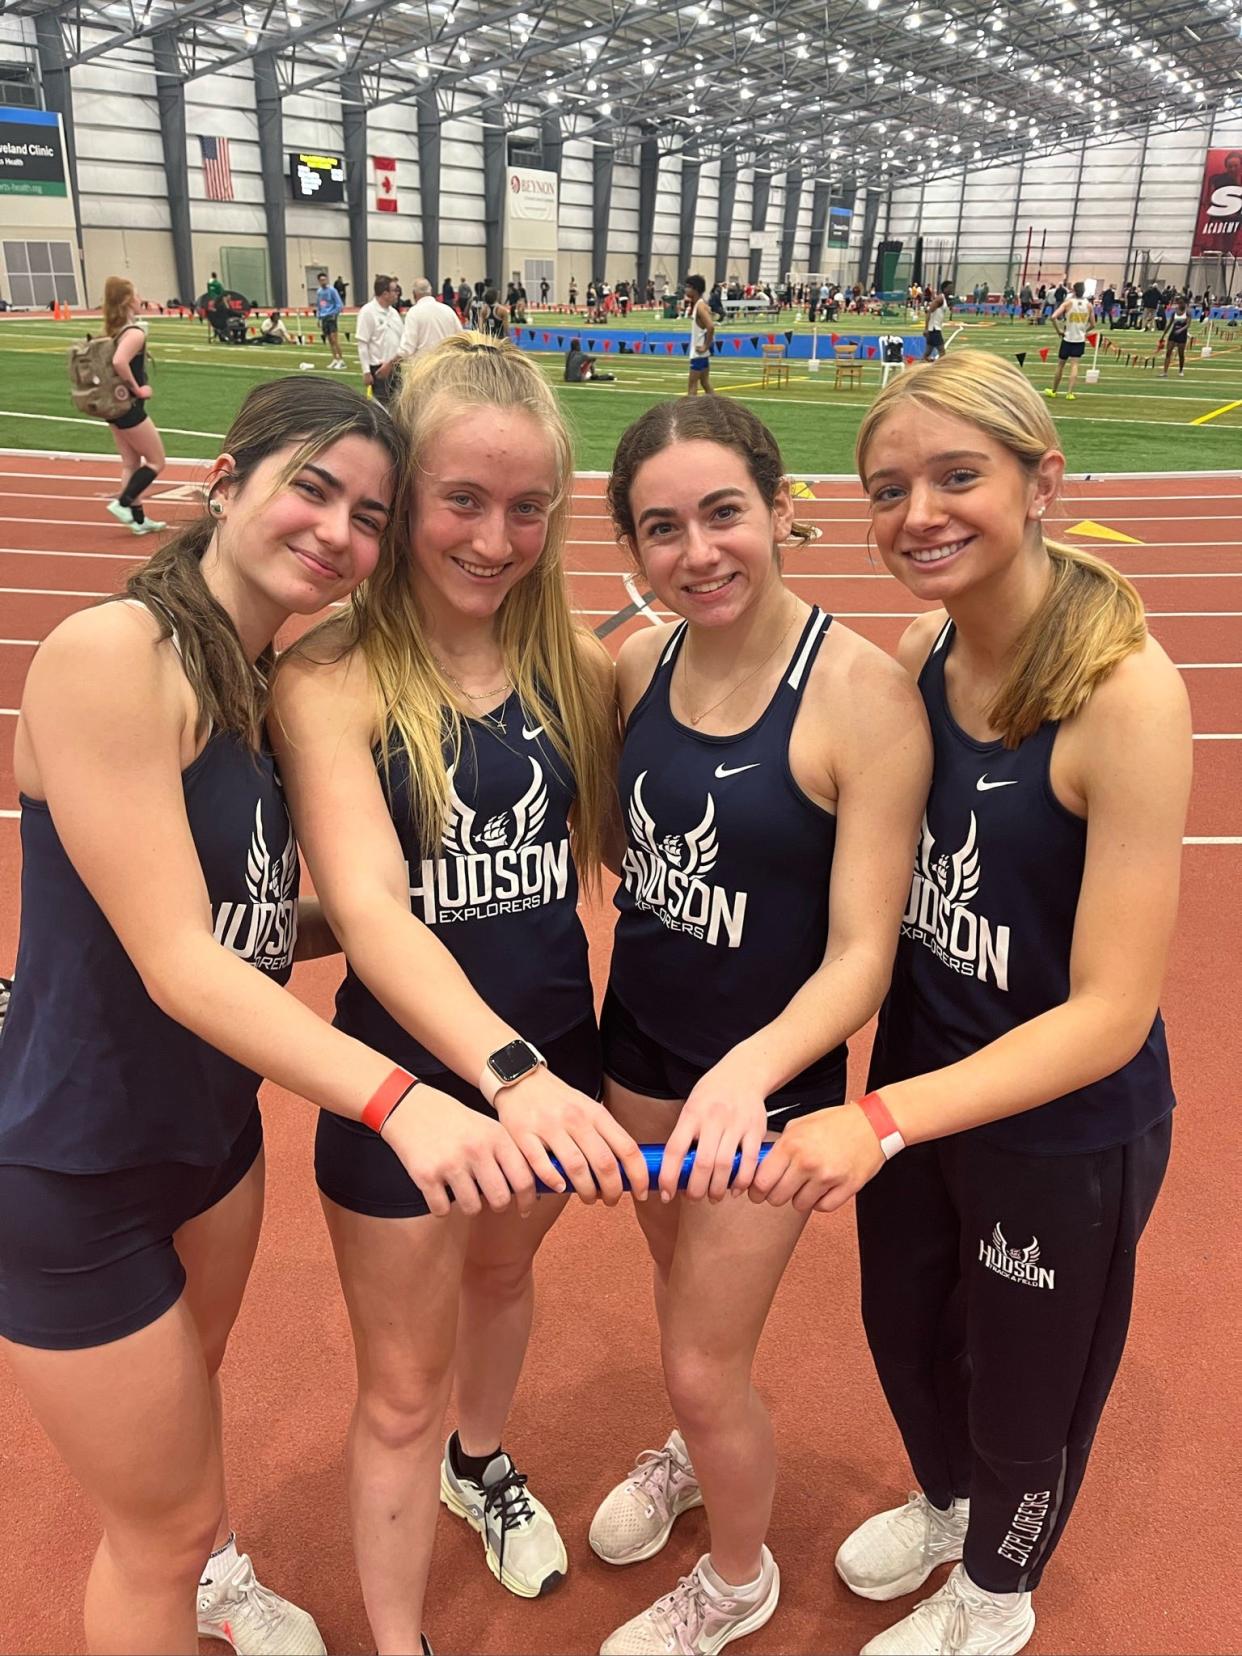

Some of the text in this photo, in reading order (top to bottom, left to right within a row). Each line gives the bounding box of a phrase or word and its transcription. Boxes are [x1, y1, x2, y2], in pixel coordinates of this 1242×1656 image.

[28, 144, 54, 157] Clinic
[521, 180, 555, 194] BEYNON
[1202, 221, 1240, 234] ACADEMY
[404, 838, 568, 925] HUDSON
[622, 847, 748, 948] HUDSON
[439, 895, 541, 924] EXPLORERS
[634, 899, 705, 940] XPLORERS
[900, 924, 975, 977] XPLORERS
[902, 874, 1010, 992] UDSON
[979, 1239, 1055, 1290] HUDSON
[989, 1264, 1010, 1279] TRACK
[1017, 1278, 1038, 1287] FIELD
[997, 1490, 1051, 1567] EXPLORERS
